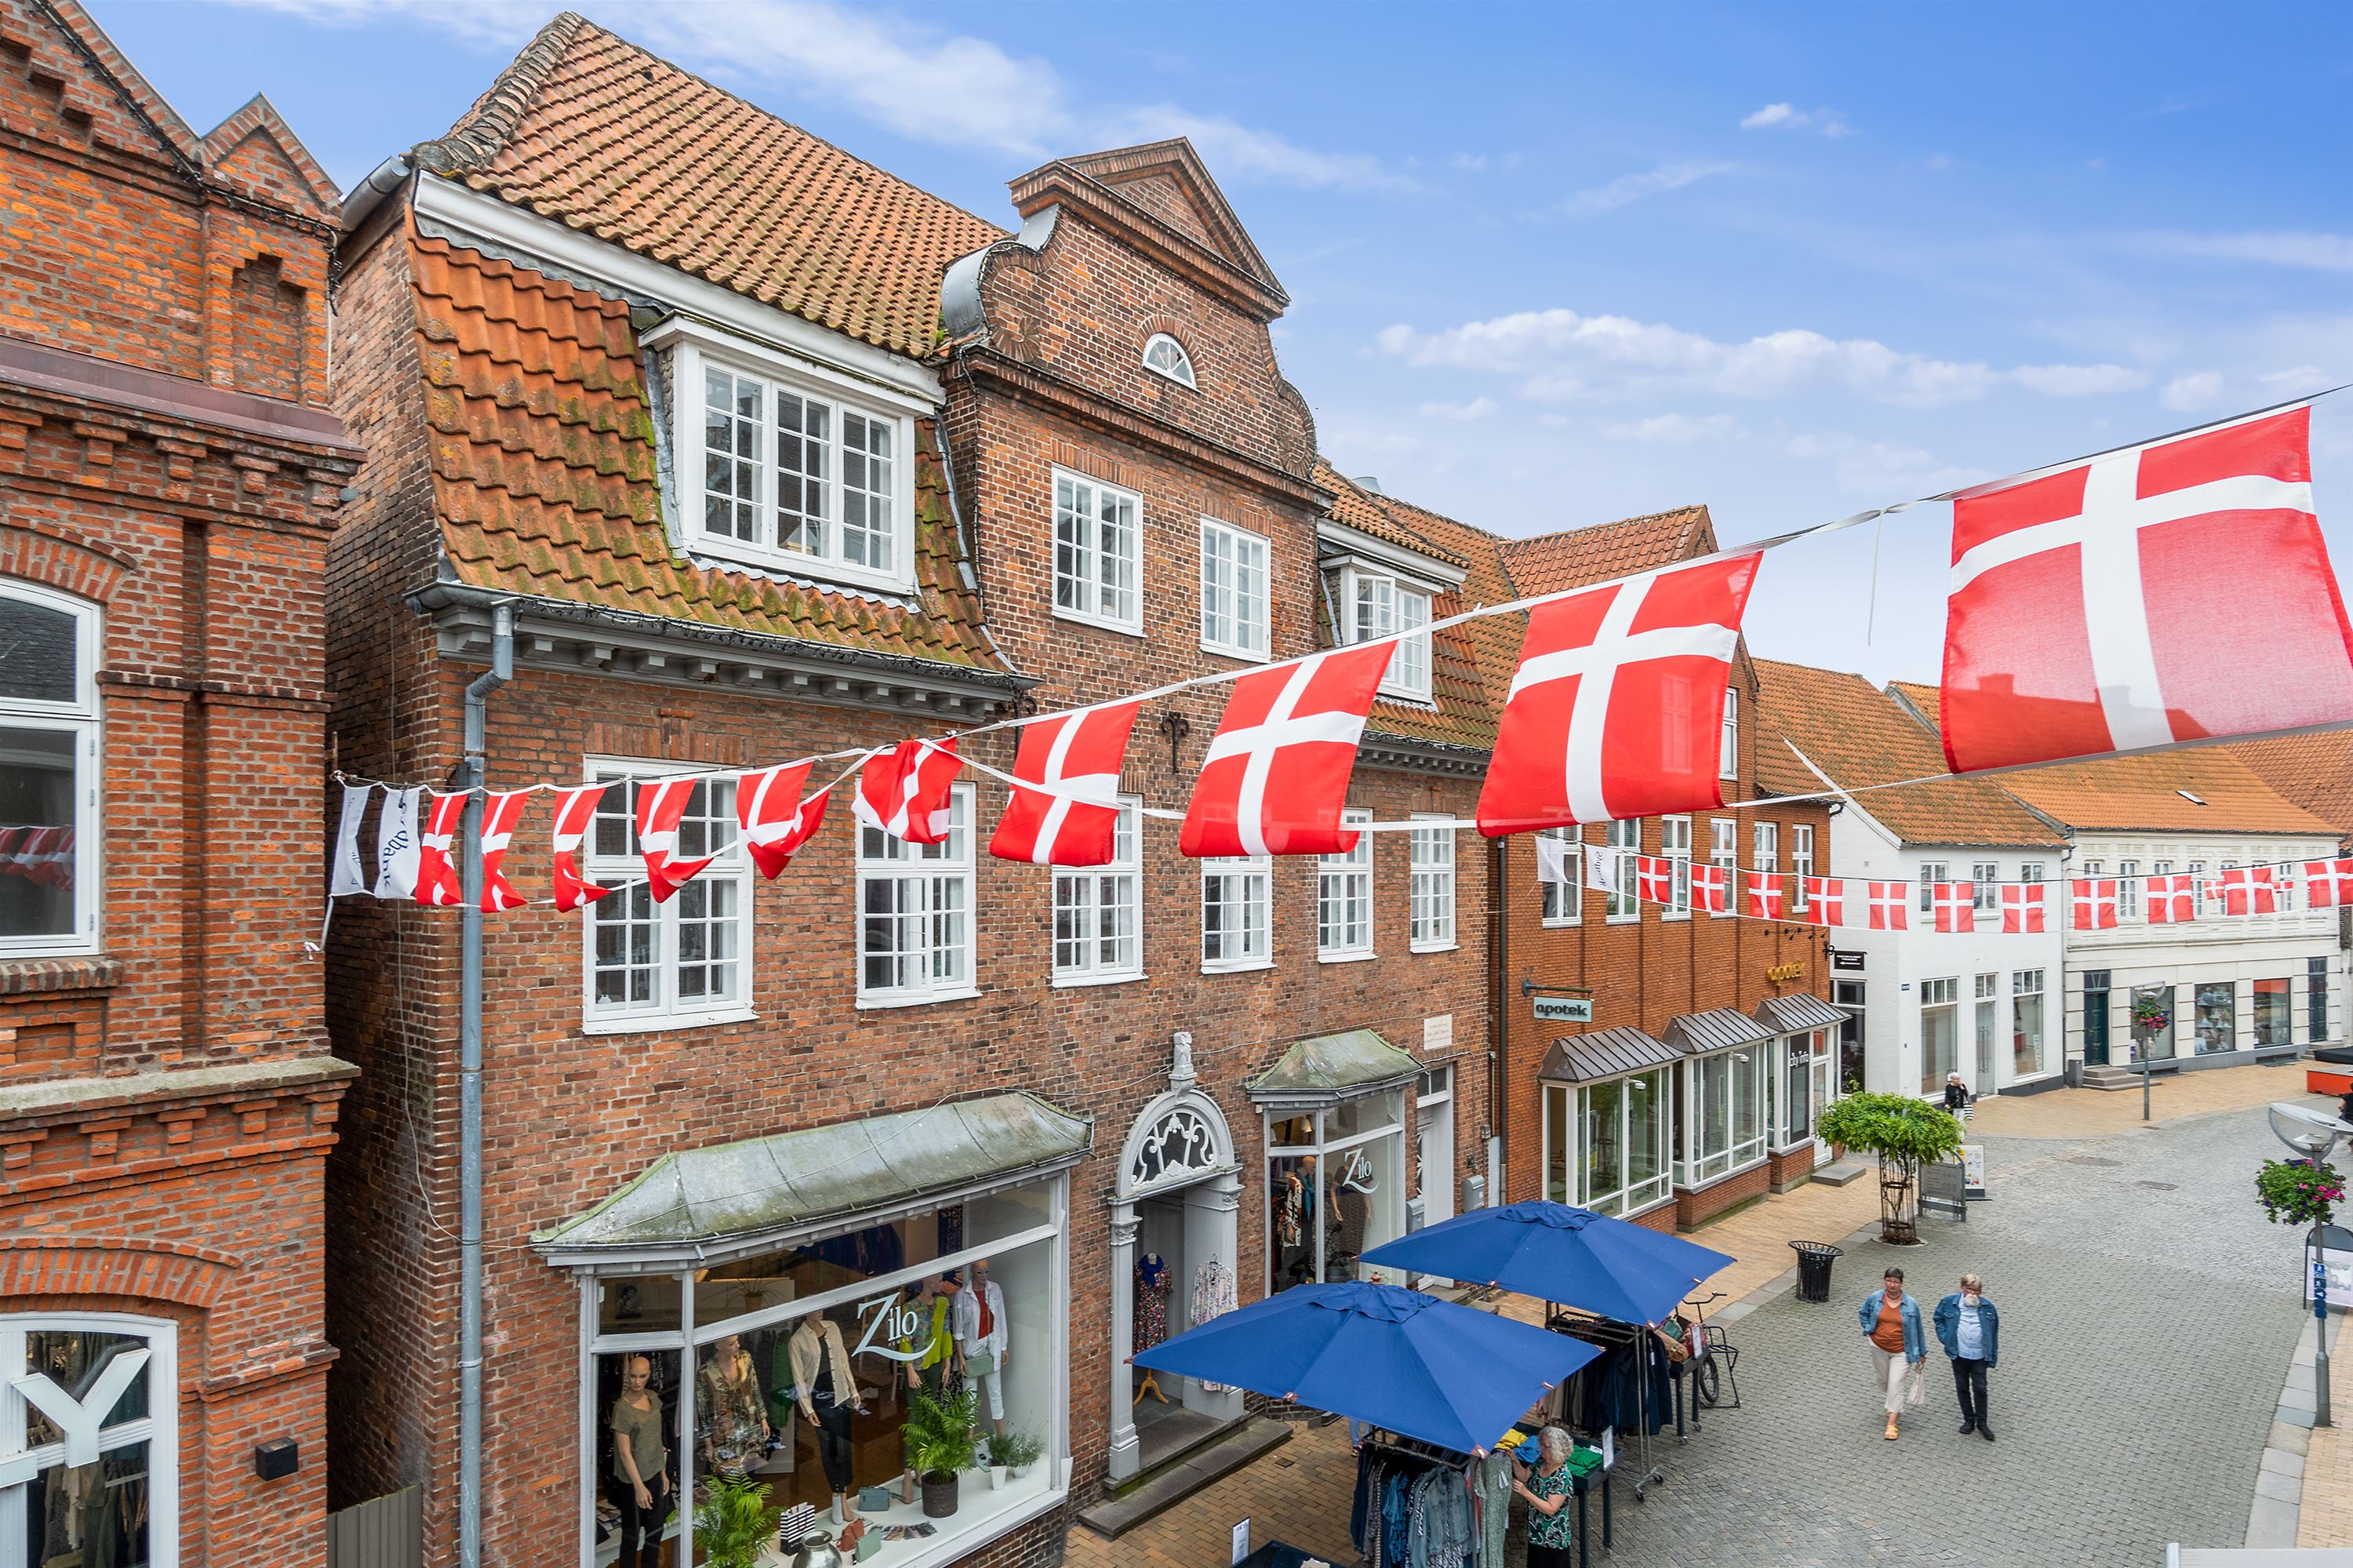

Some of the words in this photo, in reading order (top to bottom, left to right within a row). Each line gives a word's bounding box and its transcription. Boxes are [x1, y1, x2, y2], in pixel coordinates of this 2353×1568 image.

[1535, 1004, 1587, 1017] apotek
[1342, 1147, 1380, 1194] Zilo
[850, 1291, 936, 1361] Zilo
[0, 1347, 152, 1490] Y
